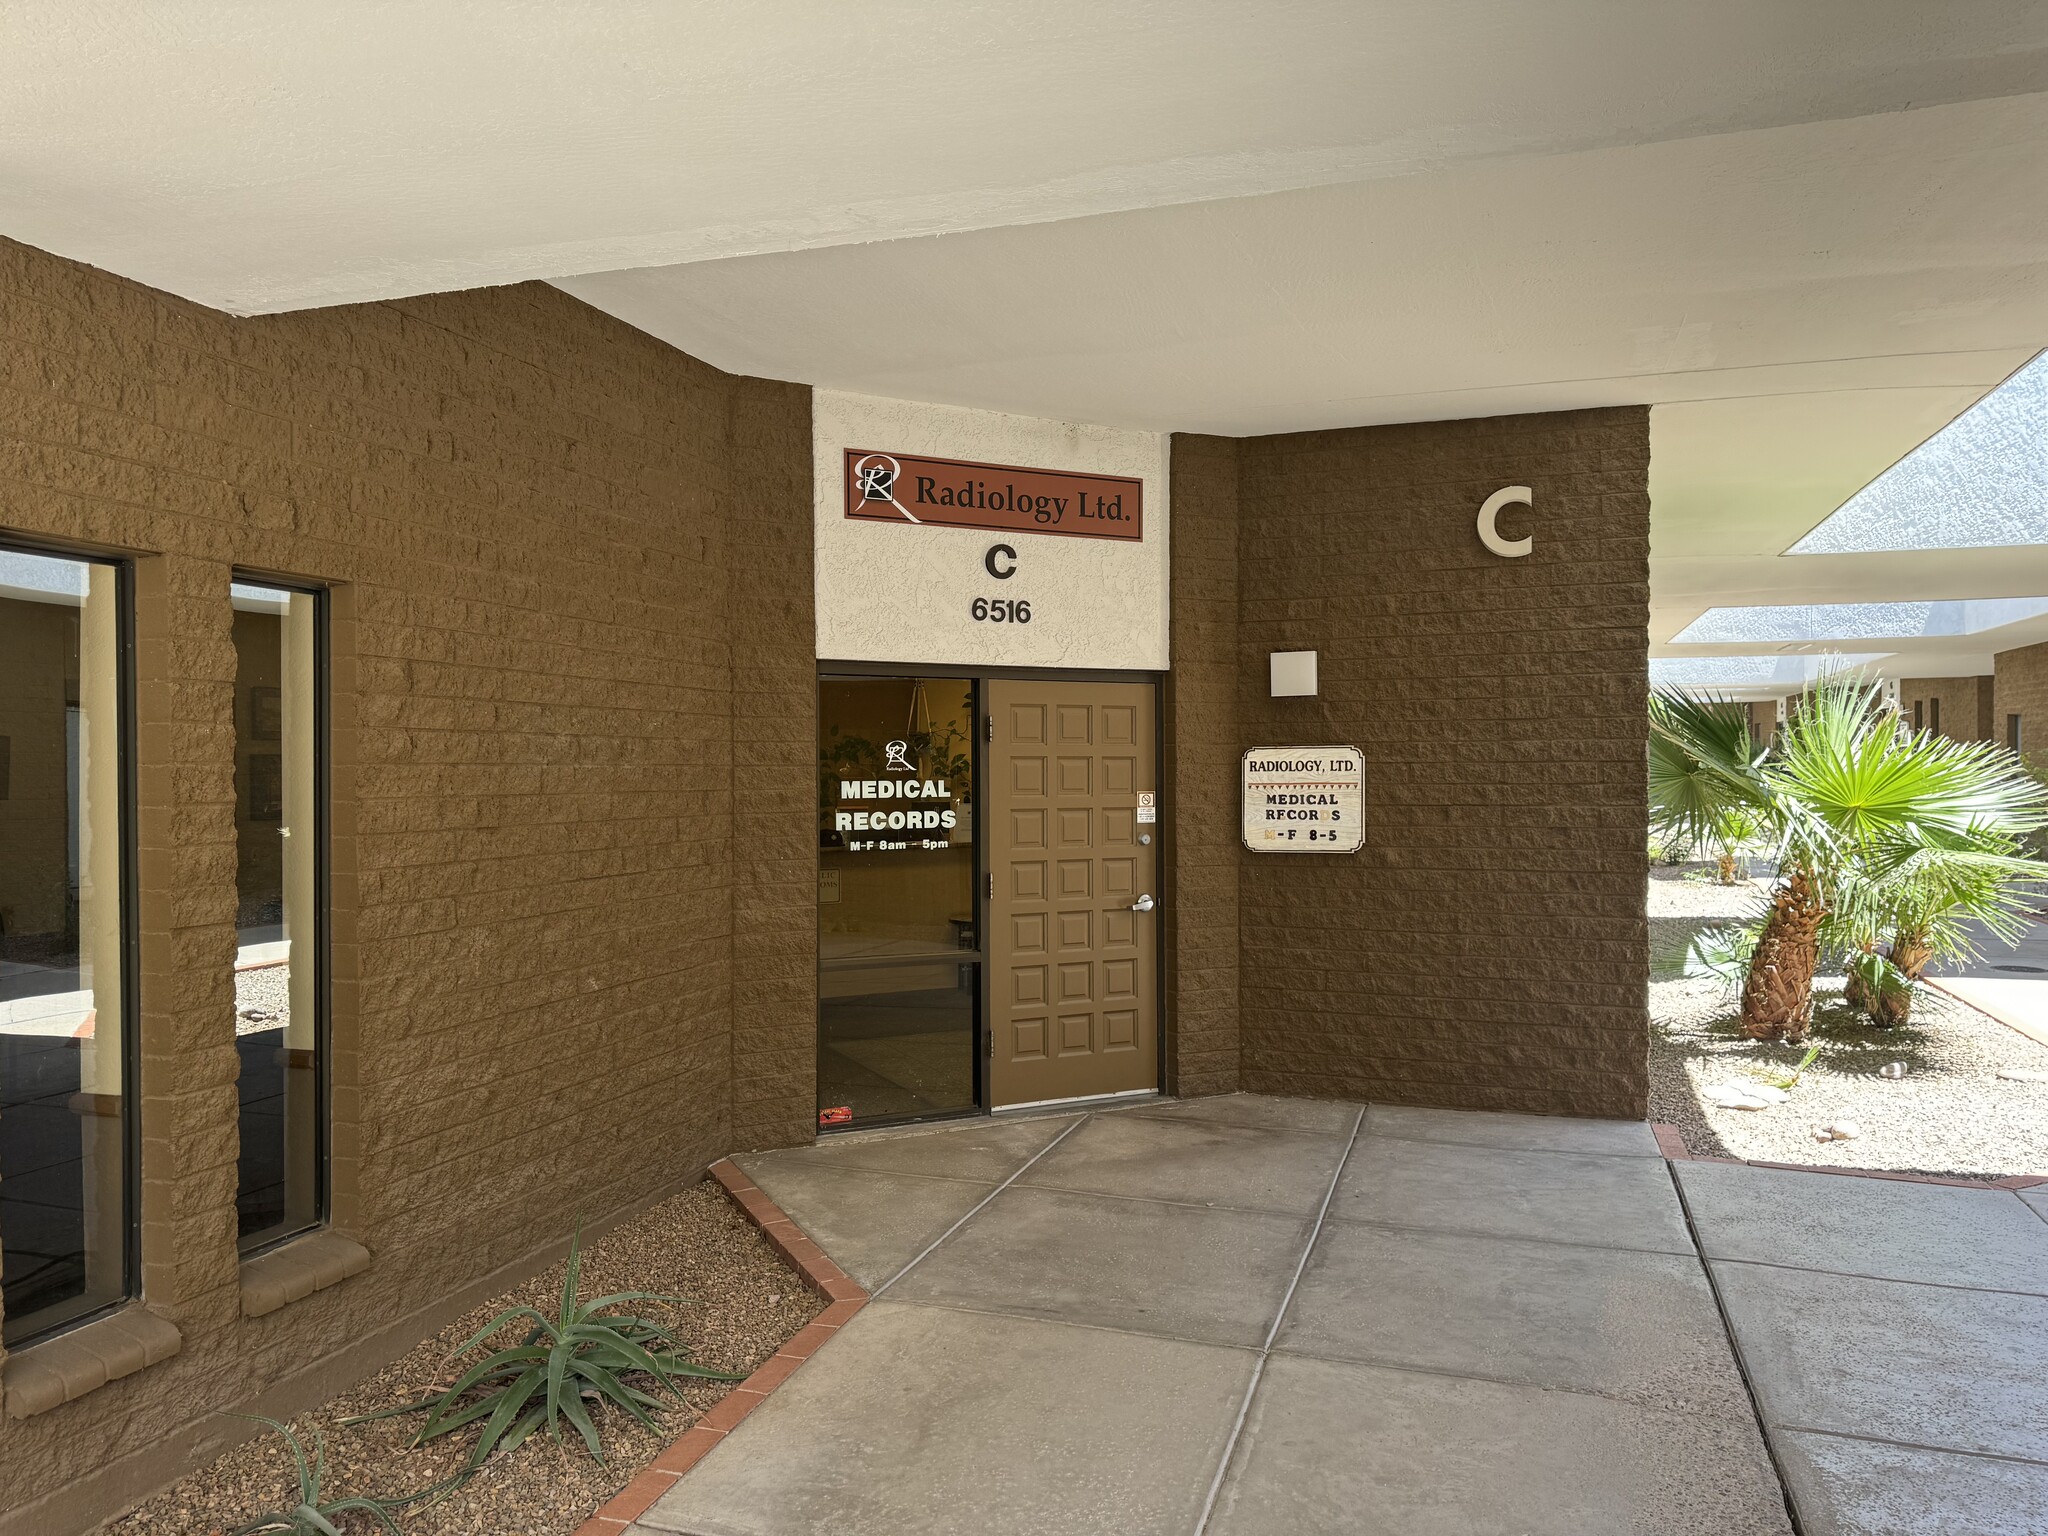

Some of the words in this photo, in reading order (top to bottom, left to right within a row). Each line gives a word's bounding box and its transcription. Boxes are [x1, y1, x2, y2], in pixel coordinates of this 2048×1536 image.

[915, 475, 1069, 525] Radiology
[1077, 491, 1131, 522] Ltd.
[1476, 485, 1533, 558] C
[984, 543, 1018, 580] C
[971, 597, 1032, 624] 6516
[1249, 759, 1326, 774] RADIOLOGY,
[1329, 759, 1357, 772] LTD.
[840, 779, 951, 800] MEDICAL
[1266, 794, 1339, 805] MEDICAL
[835, 809, 957, 832] RECORDS
[849, 840, 875, 852] M-F
[878, 839, 907, 851] 8am
[922, 839, 949, 851] 5pm
